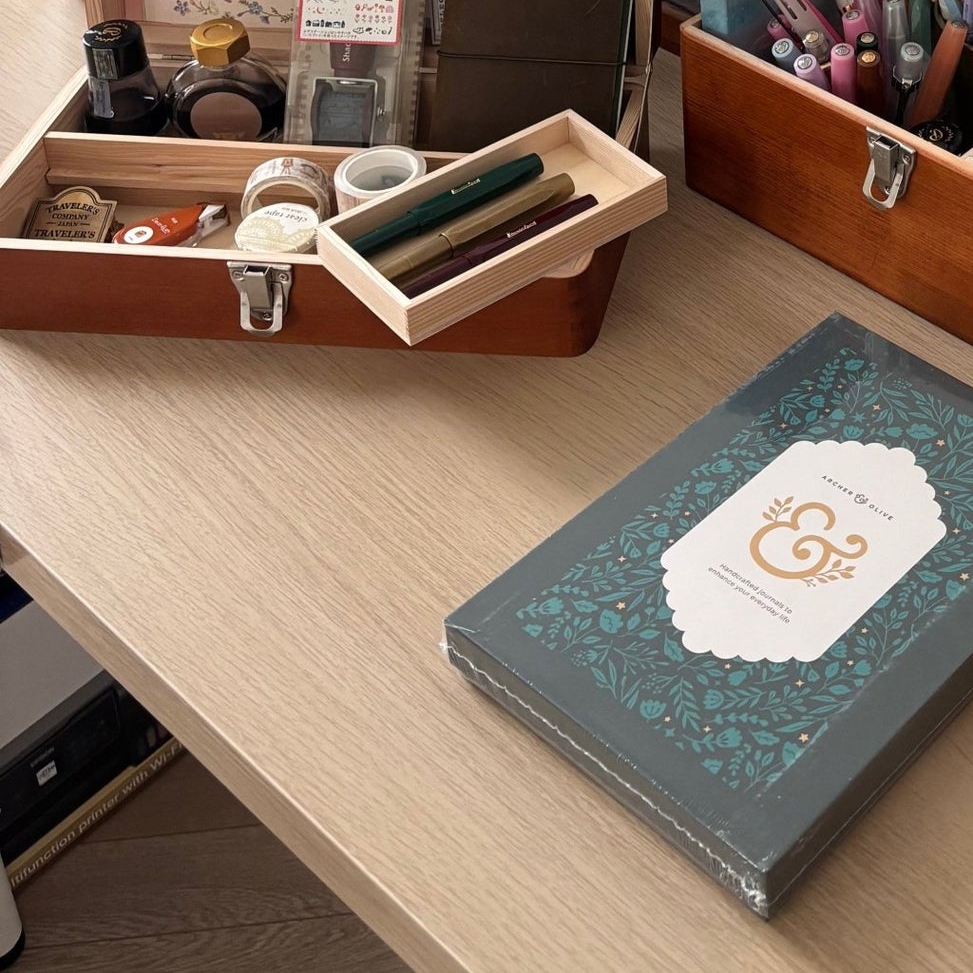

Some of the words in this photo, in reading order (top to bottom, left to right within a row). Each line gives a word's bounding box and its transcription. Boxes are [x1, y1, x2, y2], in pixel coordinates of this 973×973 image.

[46, 202, 101, 216] TRAVELER'S
[51, 212, 90, 221] COMPANY
[34, 228, 96, 239] TRAVELER'S
[821, 475, 854, 496] ARCHER
[868, 503, 894, 521] OLIVE
[707, 566, 736, 587] enhance
[733, 584, 751, 597] your
[749, 594, 779, 617] everyday
[778, 612, 790, 624] life
[719, 563, 760, 591] Handcrafted
[756, 588, 785, 609] journals
[784, 606, 793, 615] to
[11, 830, 77, 887] ltifunction
[78, 796, 120, 833] printer
[122, 770, 149, 795] with
